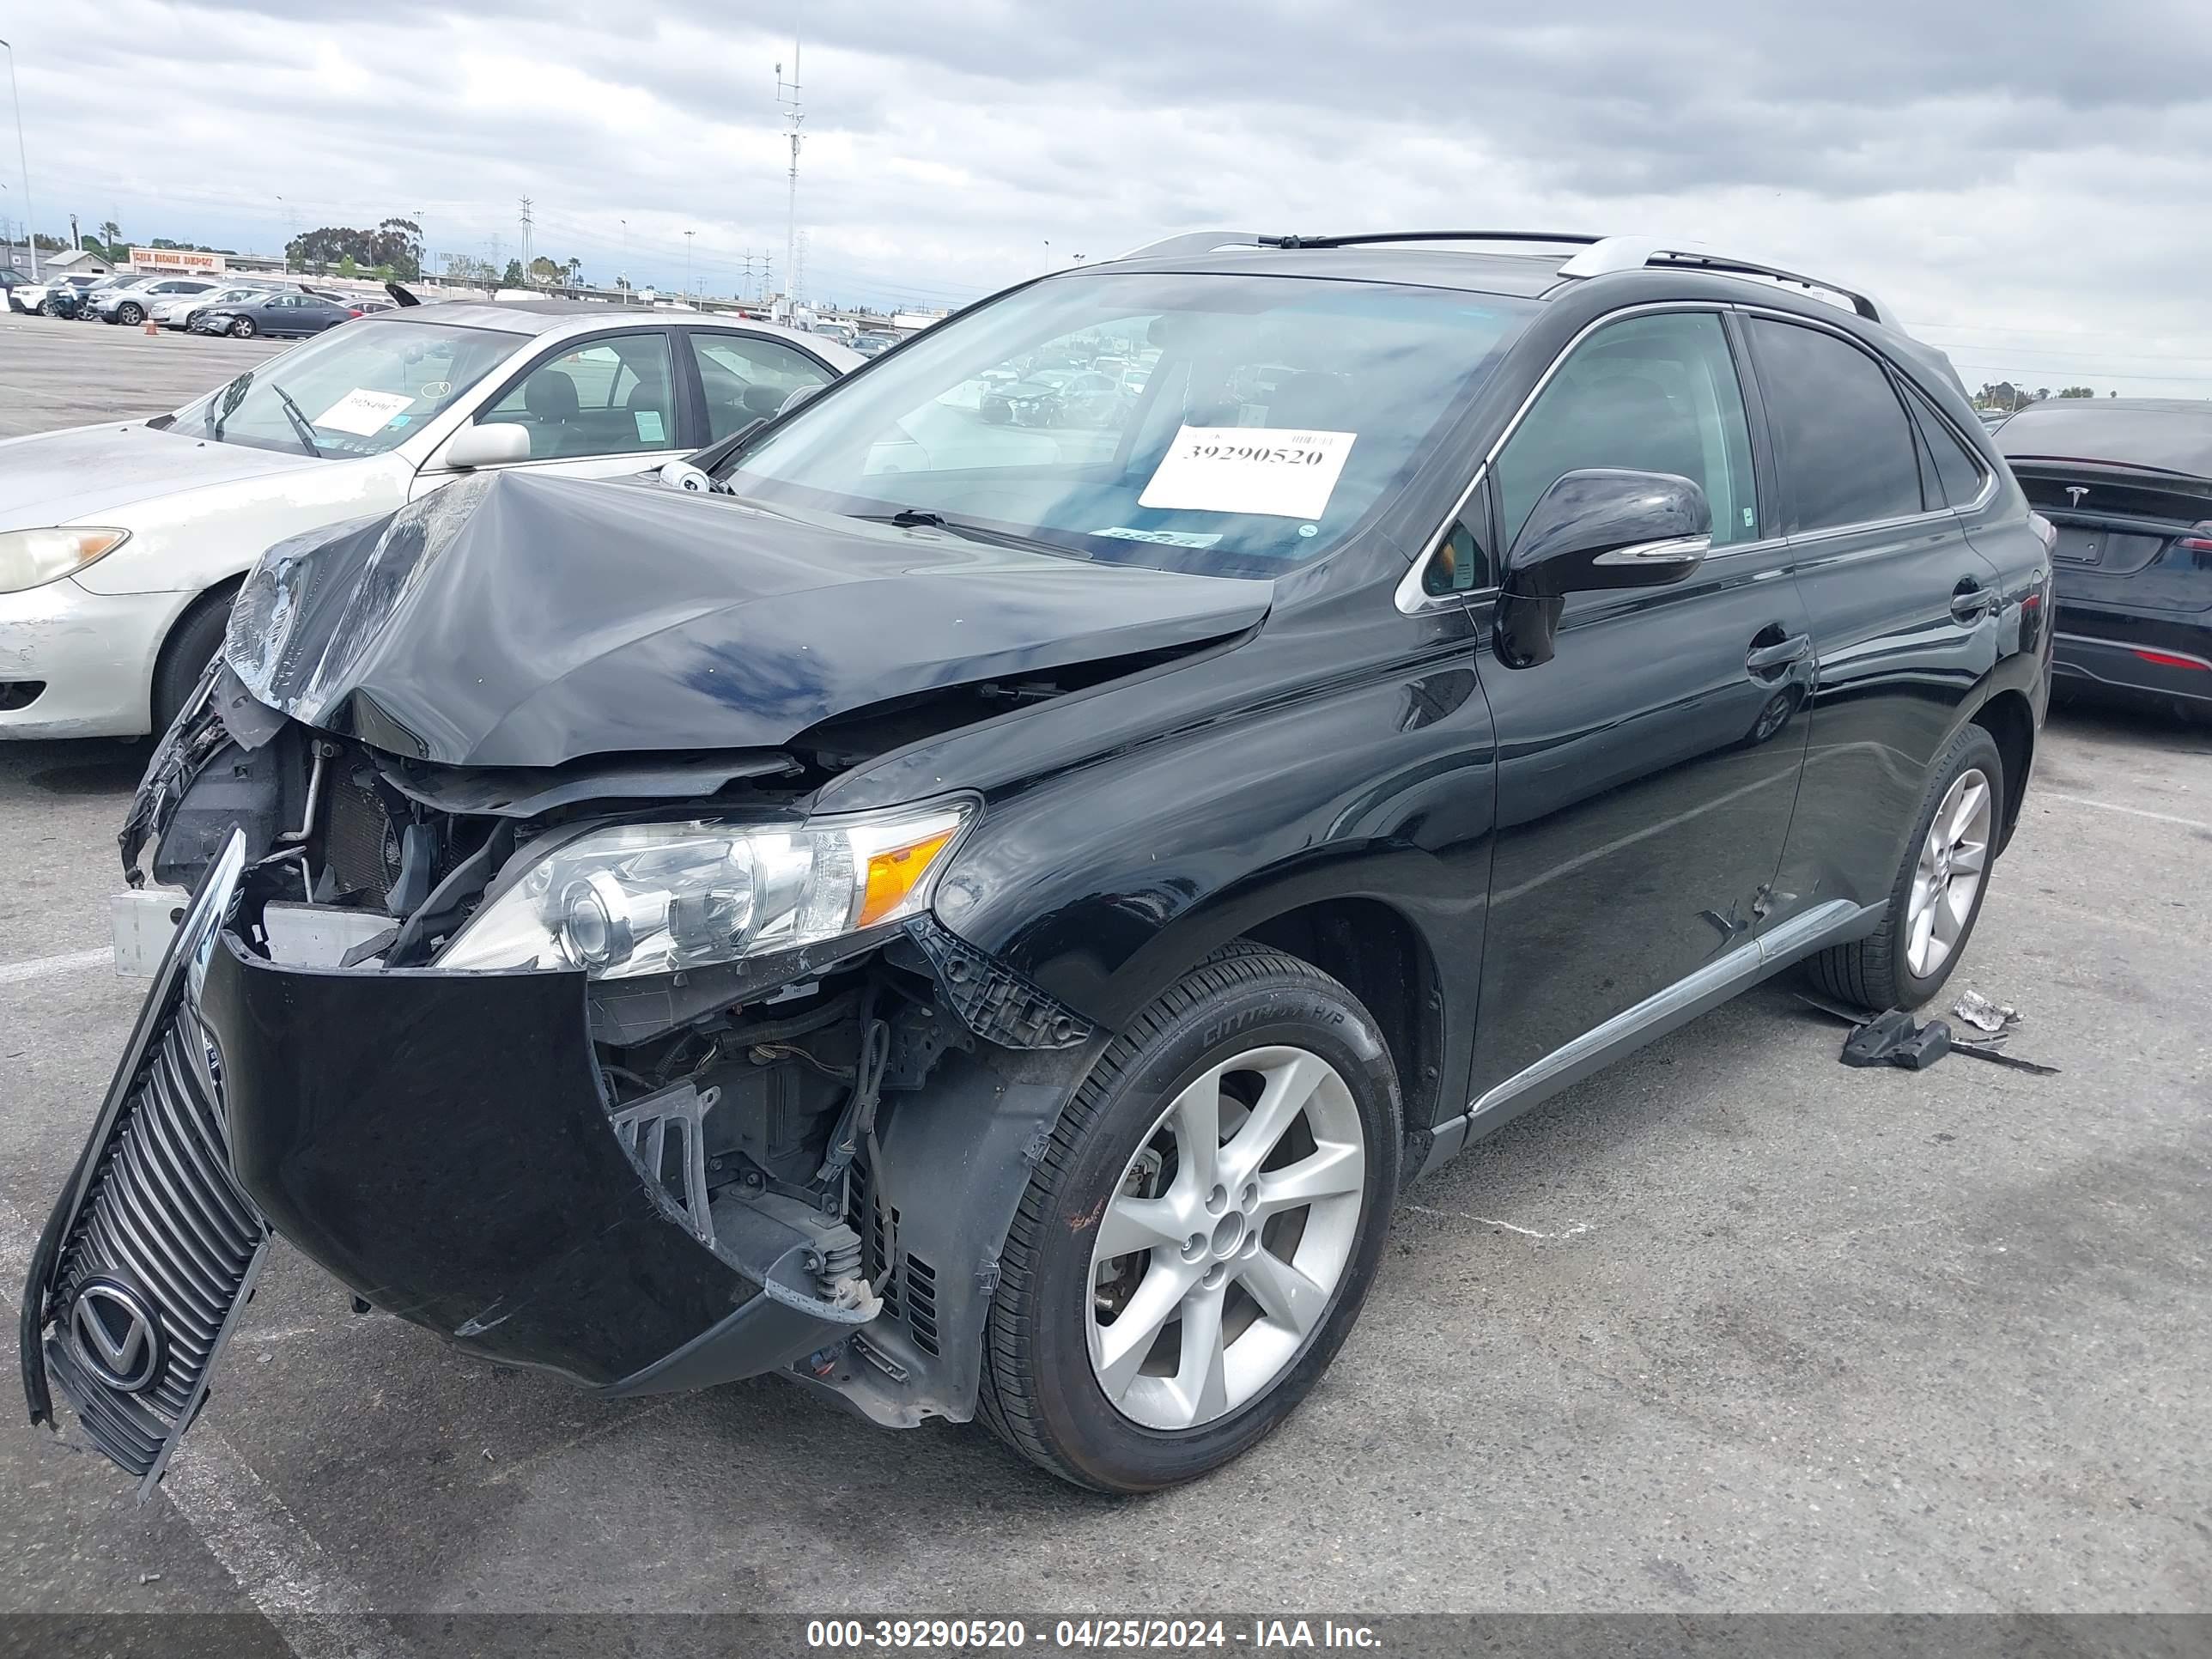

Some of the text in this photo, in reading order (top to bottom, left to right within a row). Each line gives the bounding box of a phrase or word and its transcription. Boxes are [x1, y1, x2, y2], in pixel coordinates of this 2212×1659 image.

[155, 254, 180, 264] HOME
[184, 257, 213, 267] DEPOT
[1182, 446, 1323, 465] 39290520
